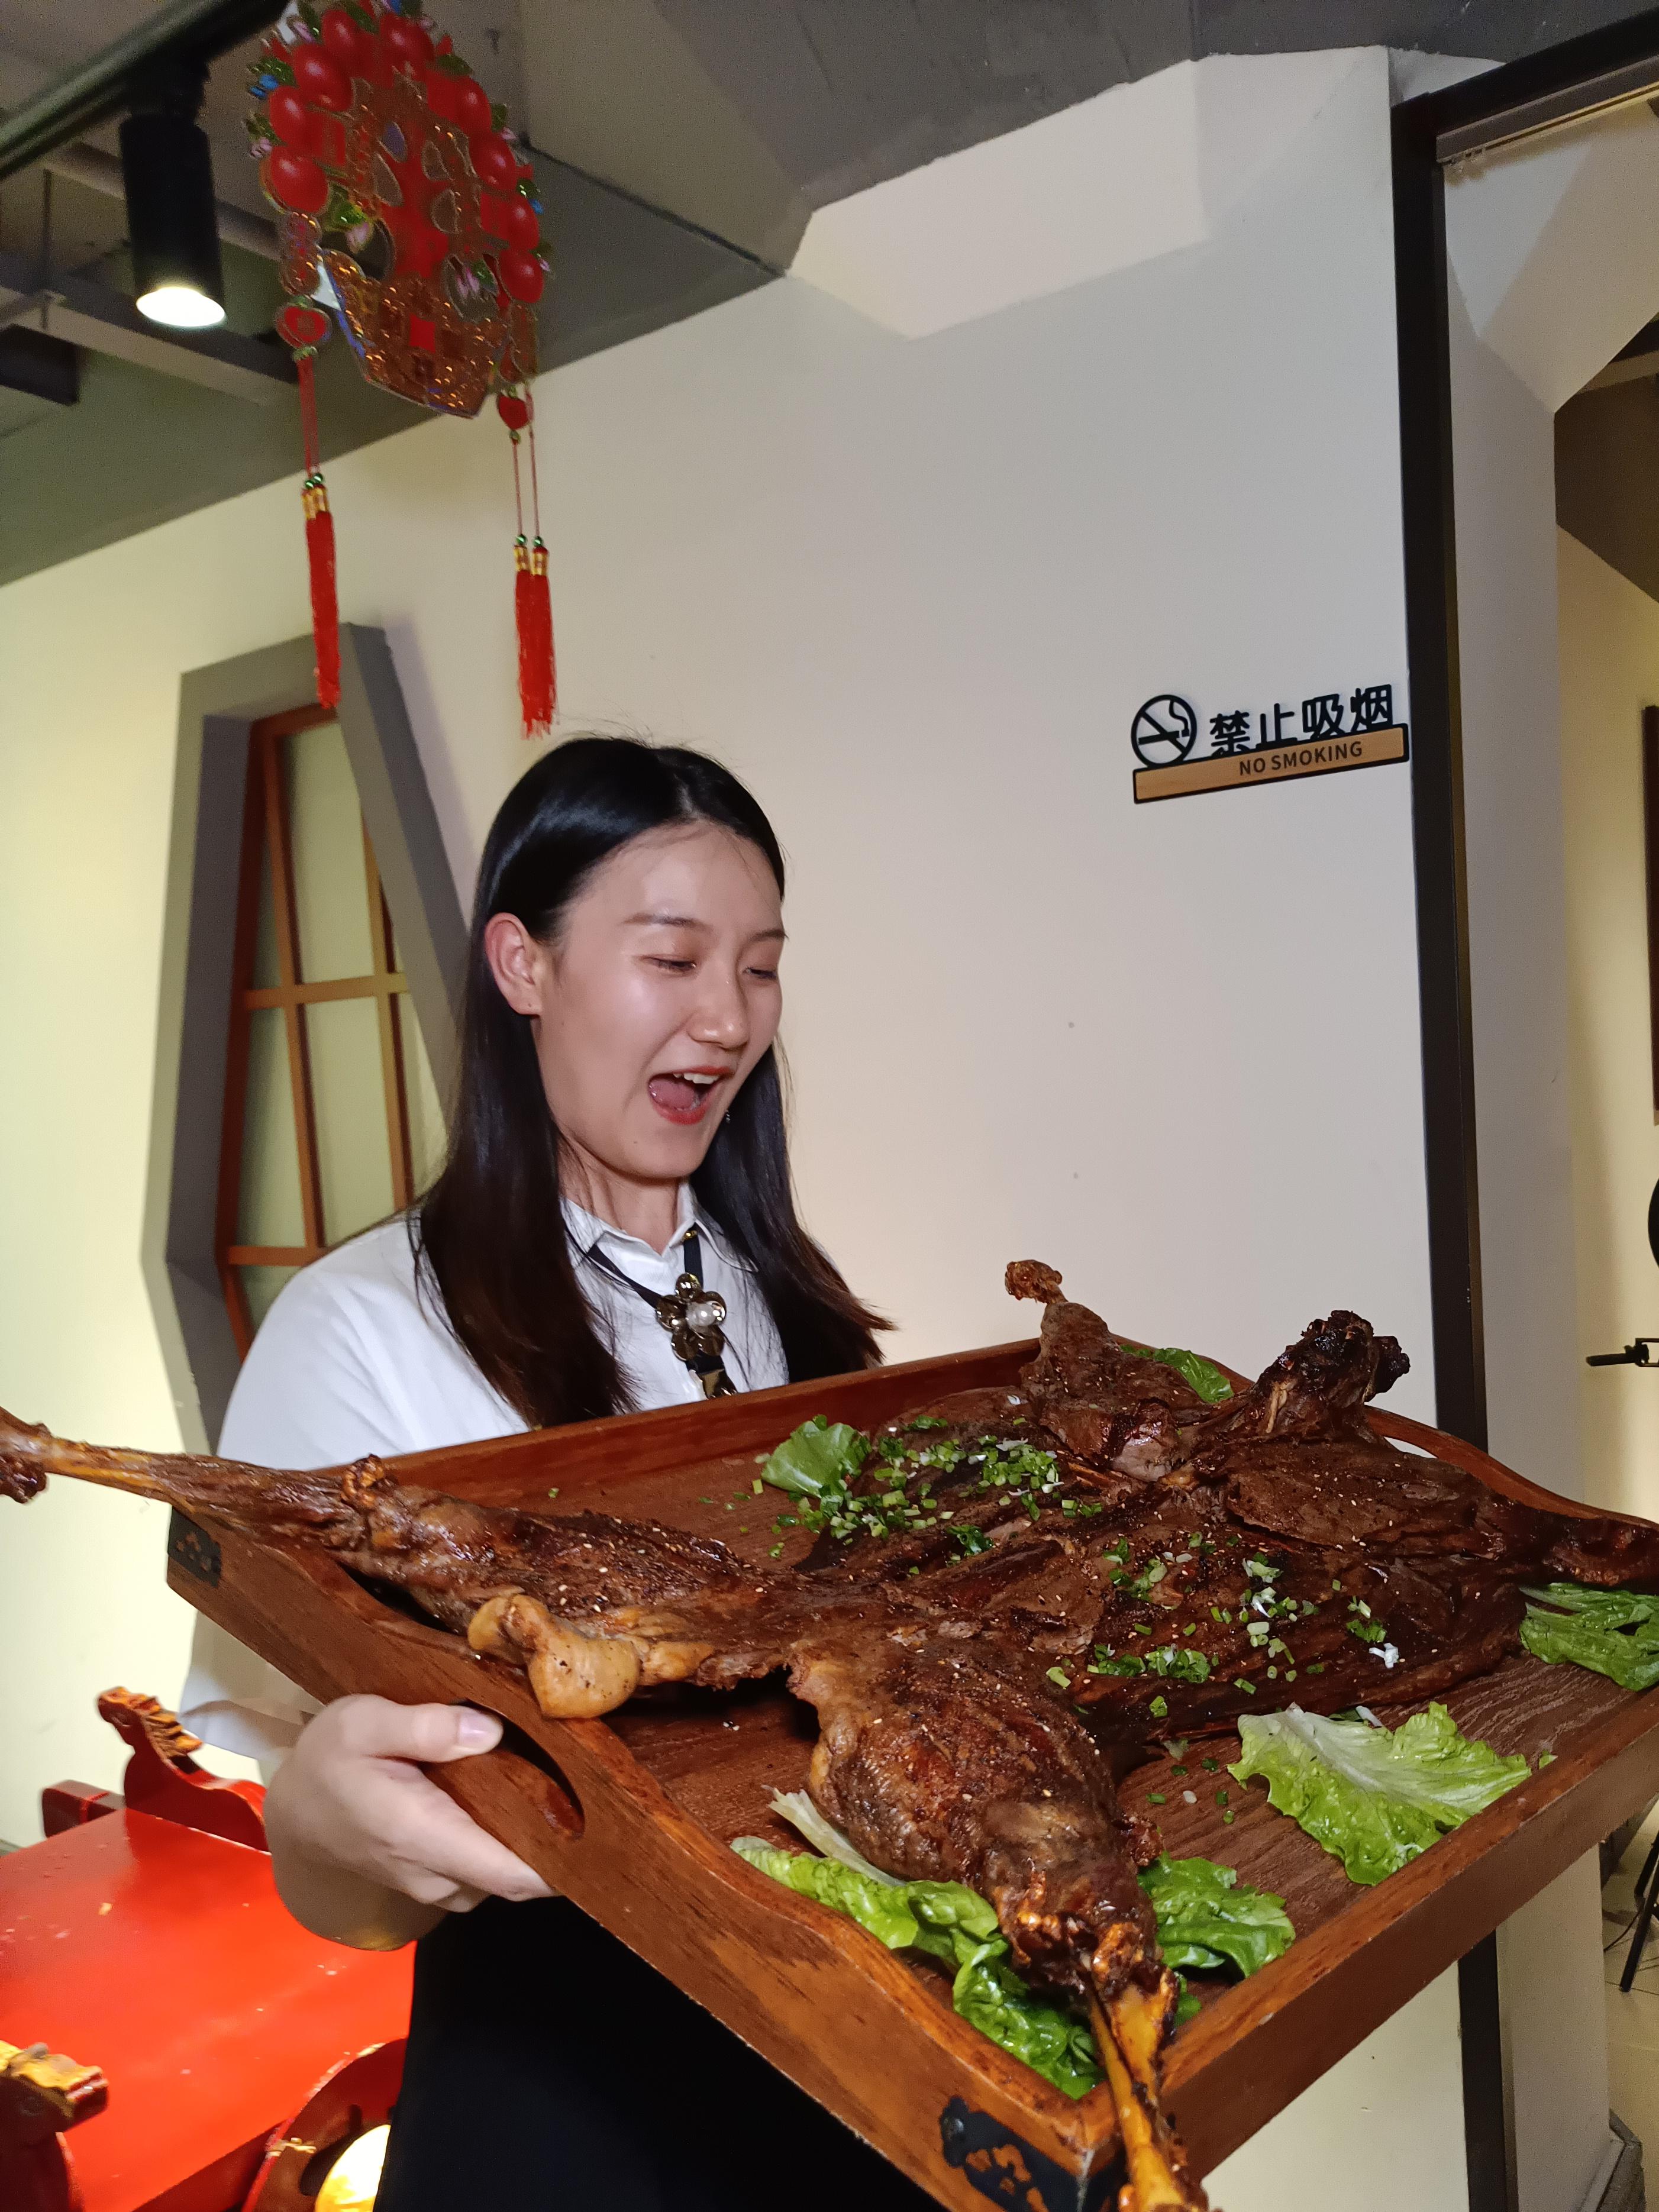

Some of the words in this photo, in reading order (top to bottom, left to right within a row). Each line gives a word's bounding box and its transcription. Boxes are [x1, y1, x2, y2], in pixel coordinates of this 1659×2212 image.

[1209, 684, 1392, 757] 禁止吸烟
[1239, 757, 1266, 776] NO
[1271, 741, 1363, 770] SMOKING
